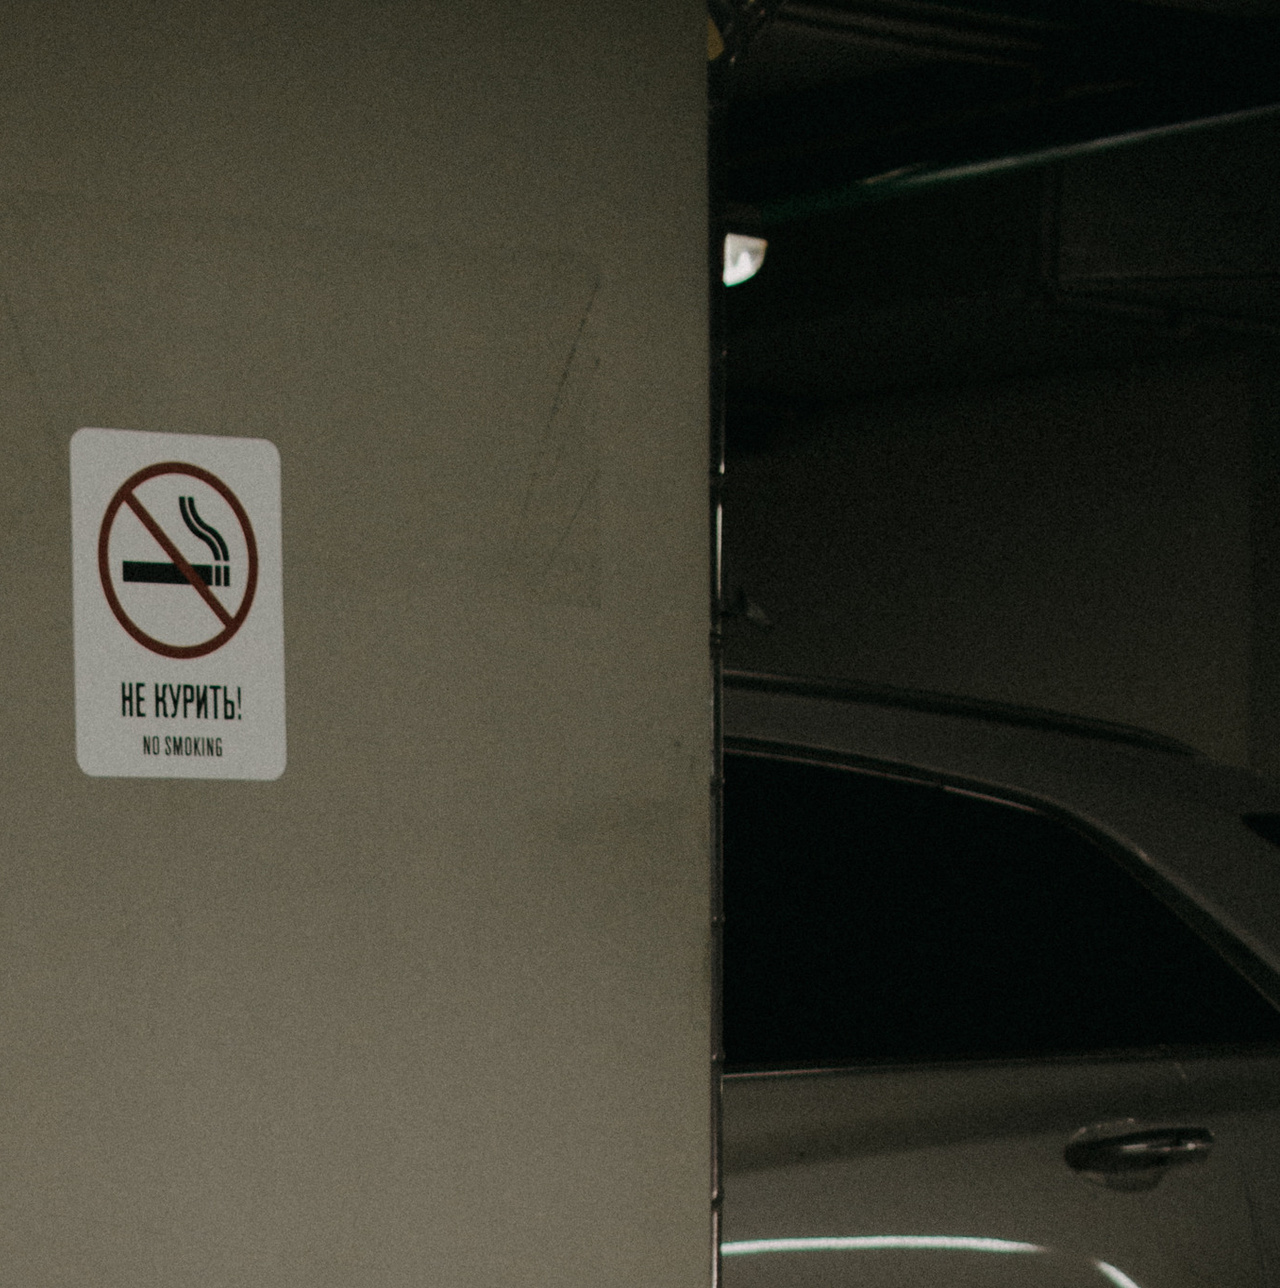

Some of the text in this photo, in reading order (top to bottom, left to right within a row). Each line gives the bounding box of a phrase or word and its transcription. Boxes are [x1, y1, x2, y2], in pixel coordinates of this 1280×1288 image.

[121, 682, 242, 720] НЕ КУРИТЬ!
[143, 735, 223, 757] NO SMOKING
